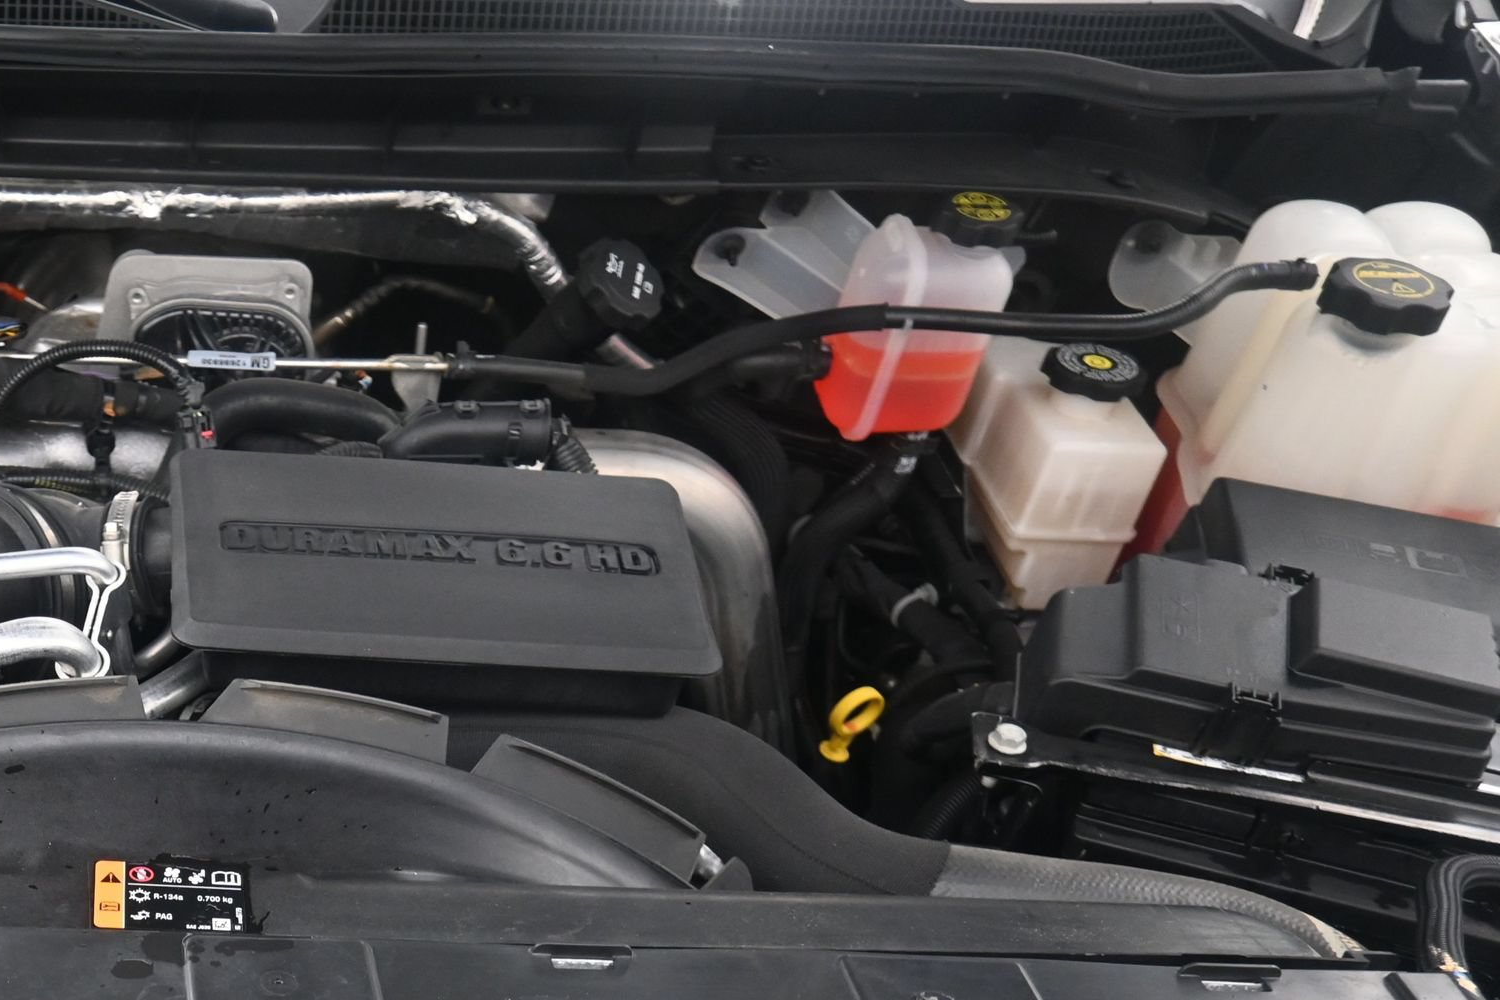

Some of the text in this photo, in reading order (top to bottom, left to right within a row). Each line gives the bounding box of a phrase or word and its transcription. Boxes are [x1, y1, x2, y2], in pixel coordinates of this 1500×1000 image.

[251, 356, 270, 368] GM
[226, 525, 655, 576] DURAMAX 6.6 HD
[153, 893, 184, 901] R-134a
[222, 896, 233, 904] kg
[155, 912, 173, 921] PAG
